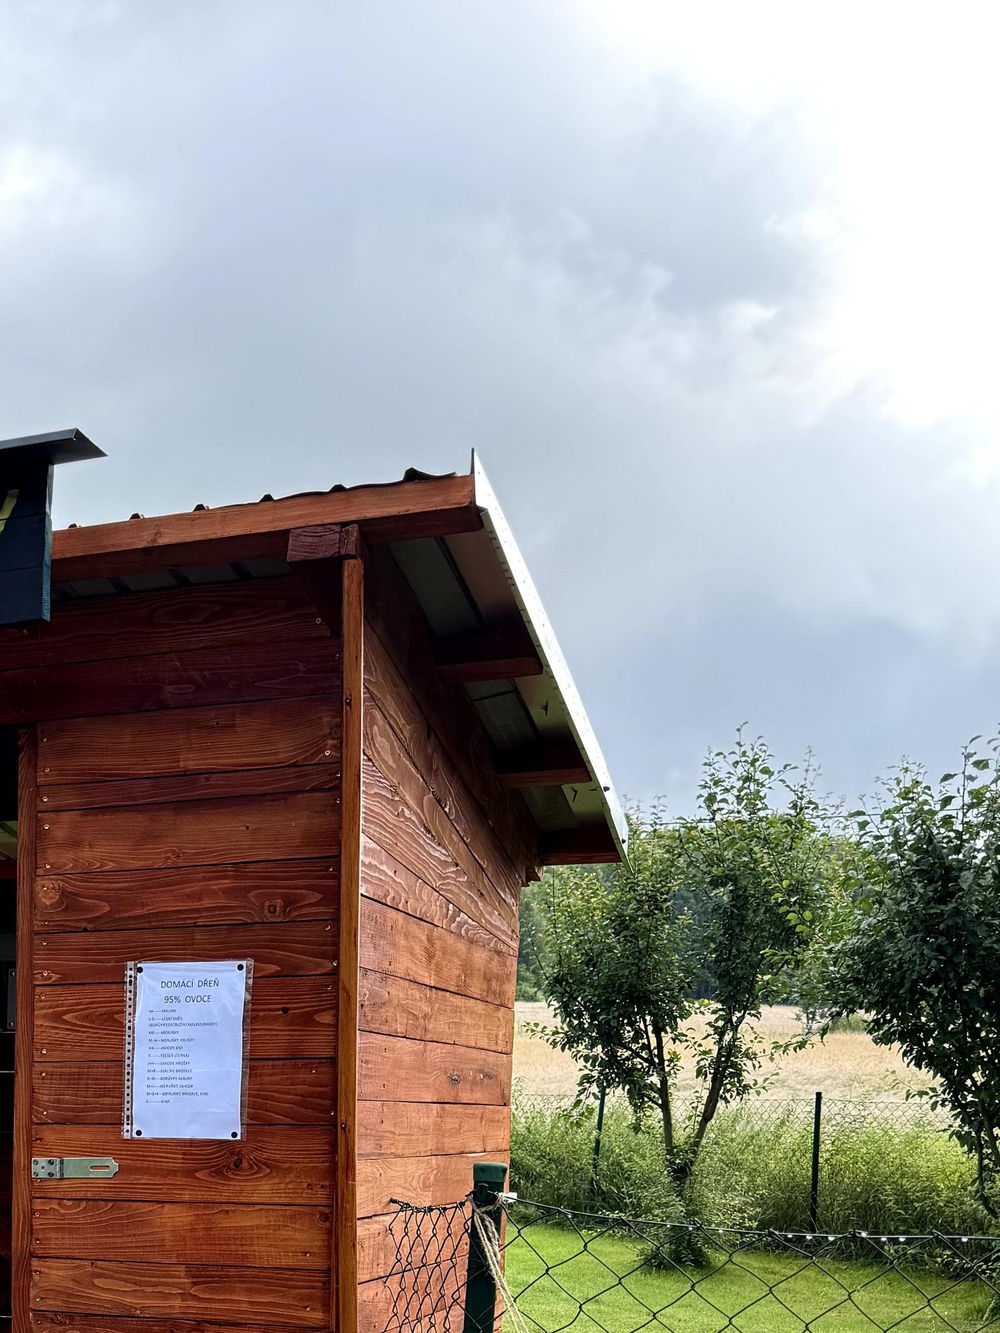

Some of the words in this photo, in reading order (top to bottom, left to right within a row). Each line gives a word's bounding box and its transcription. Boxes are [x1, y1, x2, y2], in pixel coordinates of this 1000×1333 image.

[160, 978, 194, 989] DOMÁCÍ
[197, 977, 220, 988] DŘEŇ
[164, 995, 181, 1003] 95%
[184, 994, 212, 1003] OVOCE
